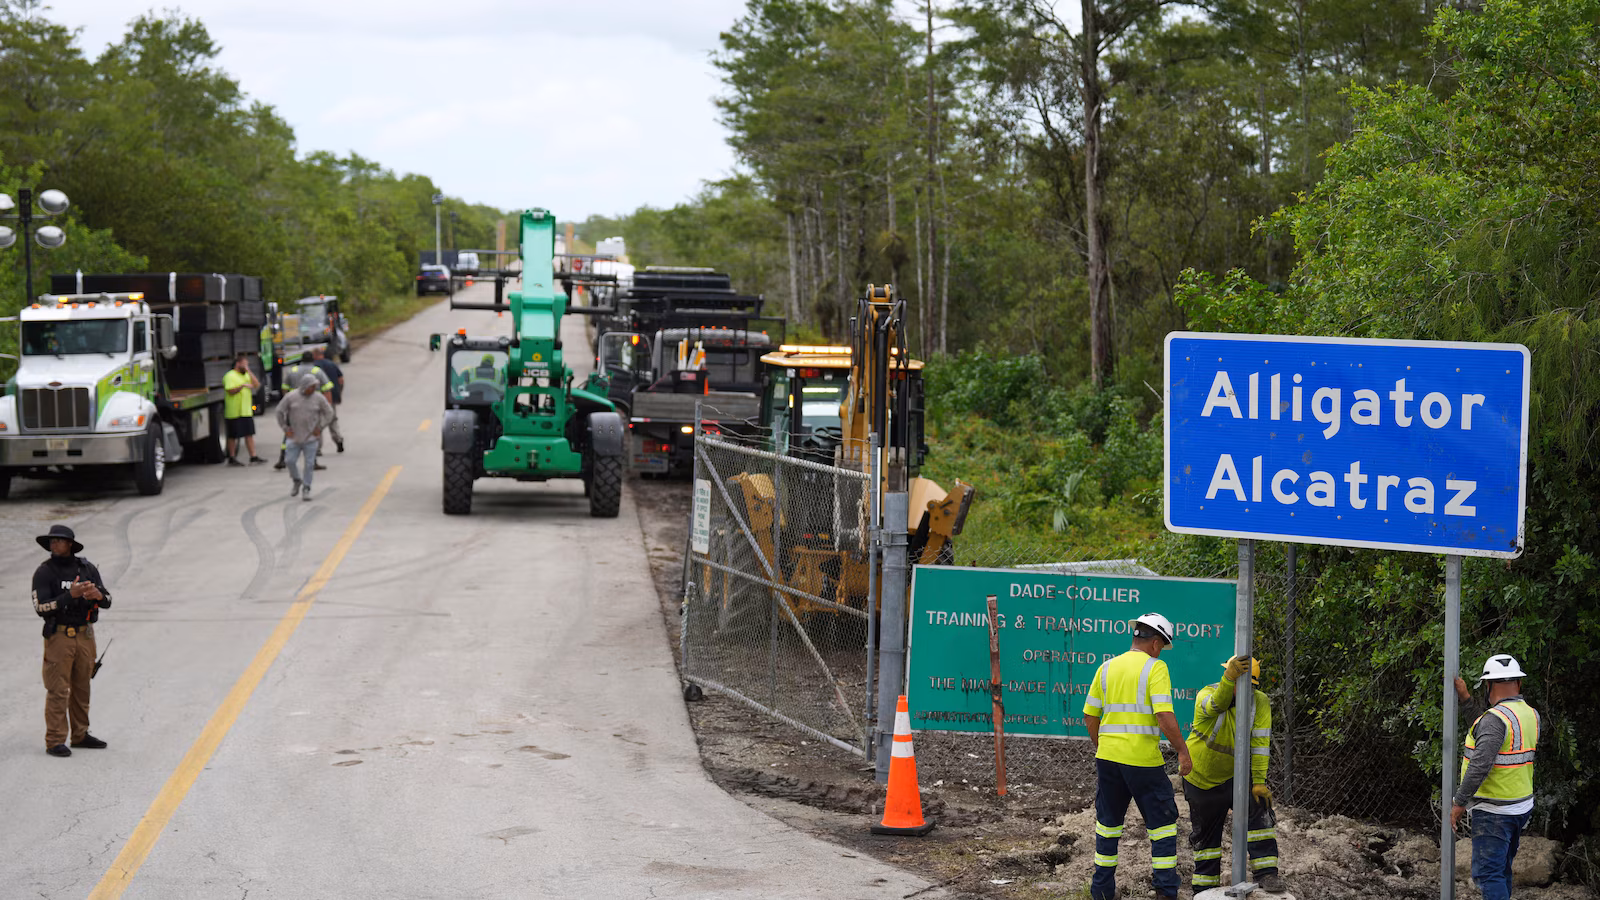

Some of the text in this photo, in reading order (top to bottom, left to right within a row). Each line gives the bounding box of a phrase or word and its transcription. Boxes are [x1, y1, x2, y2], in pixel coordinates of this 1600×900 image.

[1200, 371, 1486, 440] Alligator
[1205, 454, 1477, 517] Alcatraz
[1009, 583, 1140, 603] DADE-COLLIER
[1014, 614, 1026, 629] &
[1022, 649, 1096, 665] OPERATED
[929, 676, 955, 690] THE
[1052, 682, 1093, 695] AVIAT
[1003, 714, 1048, 725] OFFICES
